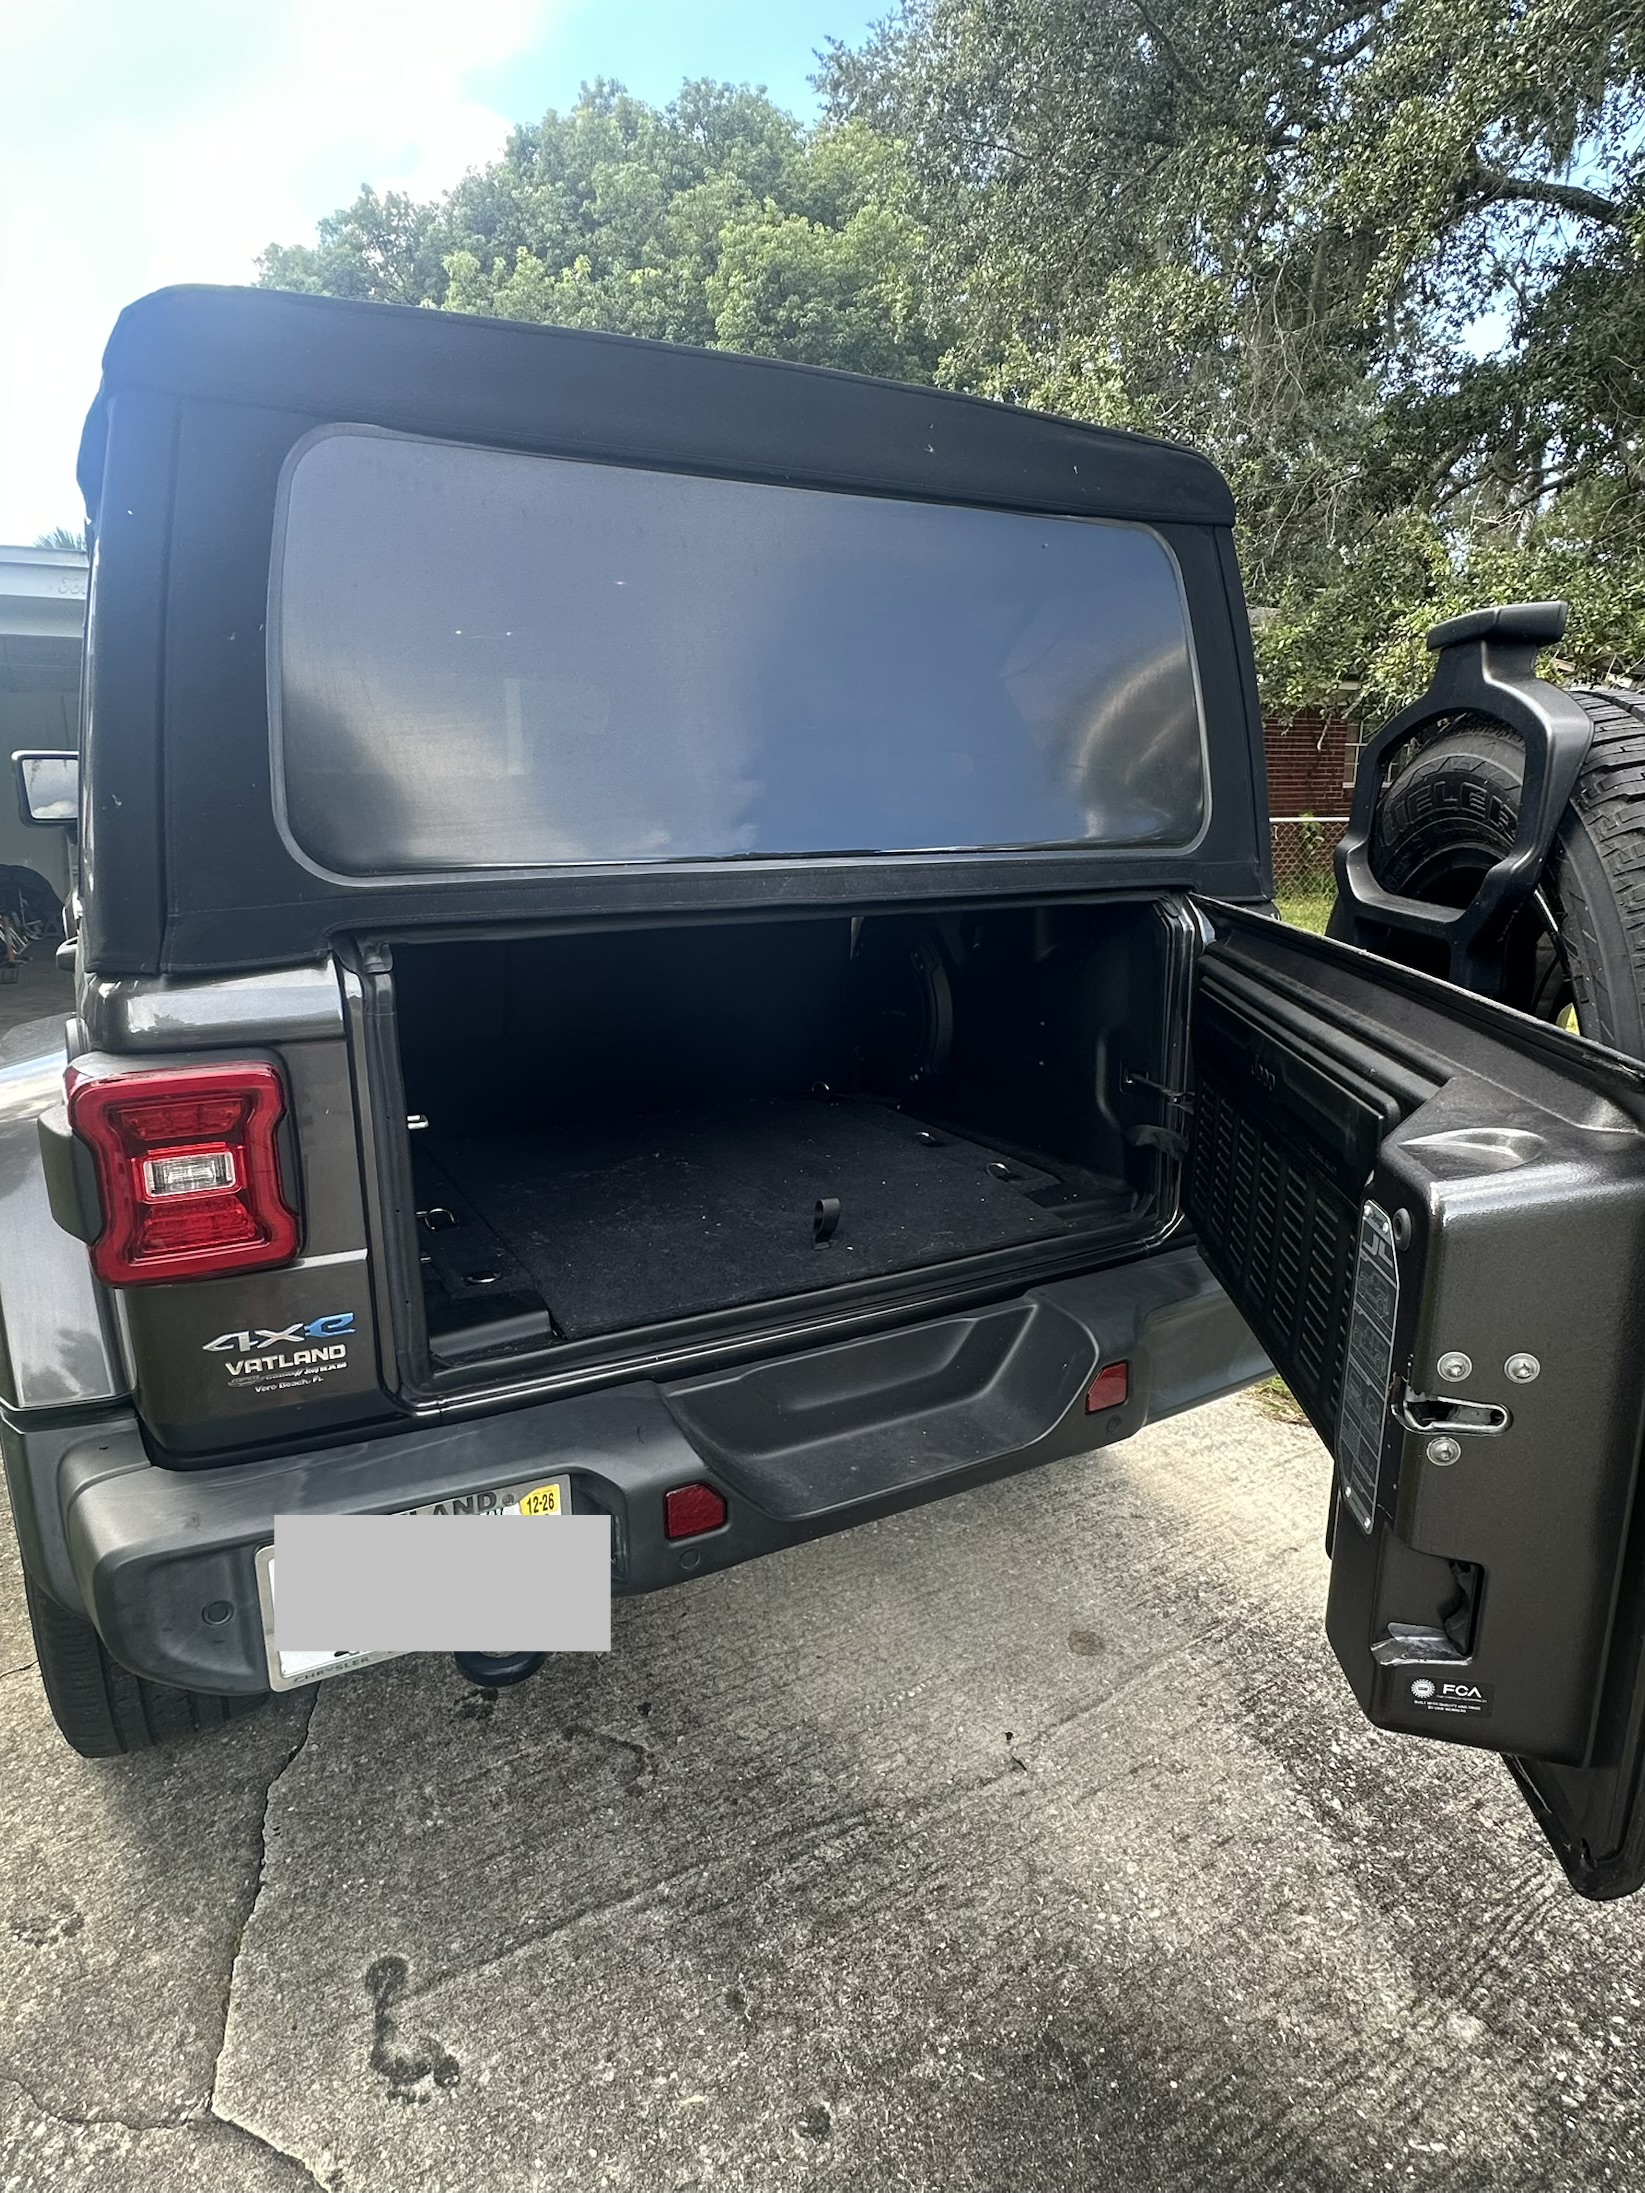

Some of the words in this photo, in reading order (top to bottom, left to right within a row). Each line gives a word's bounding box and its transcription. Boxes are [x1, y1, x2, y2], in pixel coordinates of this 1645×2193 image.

[1362, 1233, 1393, 1268] JL
[225, 1344, 347, 1376] VATLAND
[254, 1382, 277, 1393] Vero
[527, 1493, 555, 1515] 12-26
[294, 1657, 369, 1682] CHRYSLER
[1442, 1684, 1482, 1698] FCA
